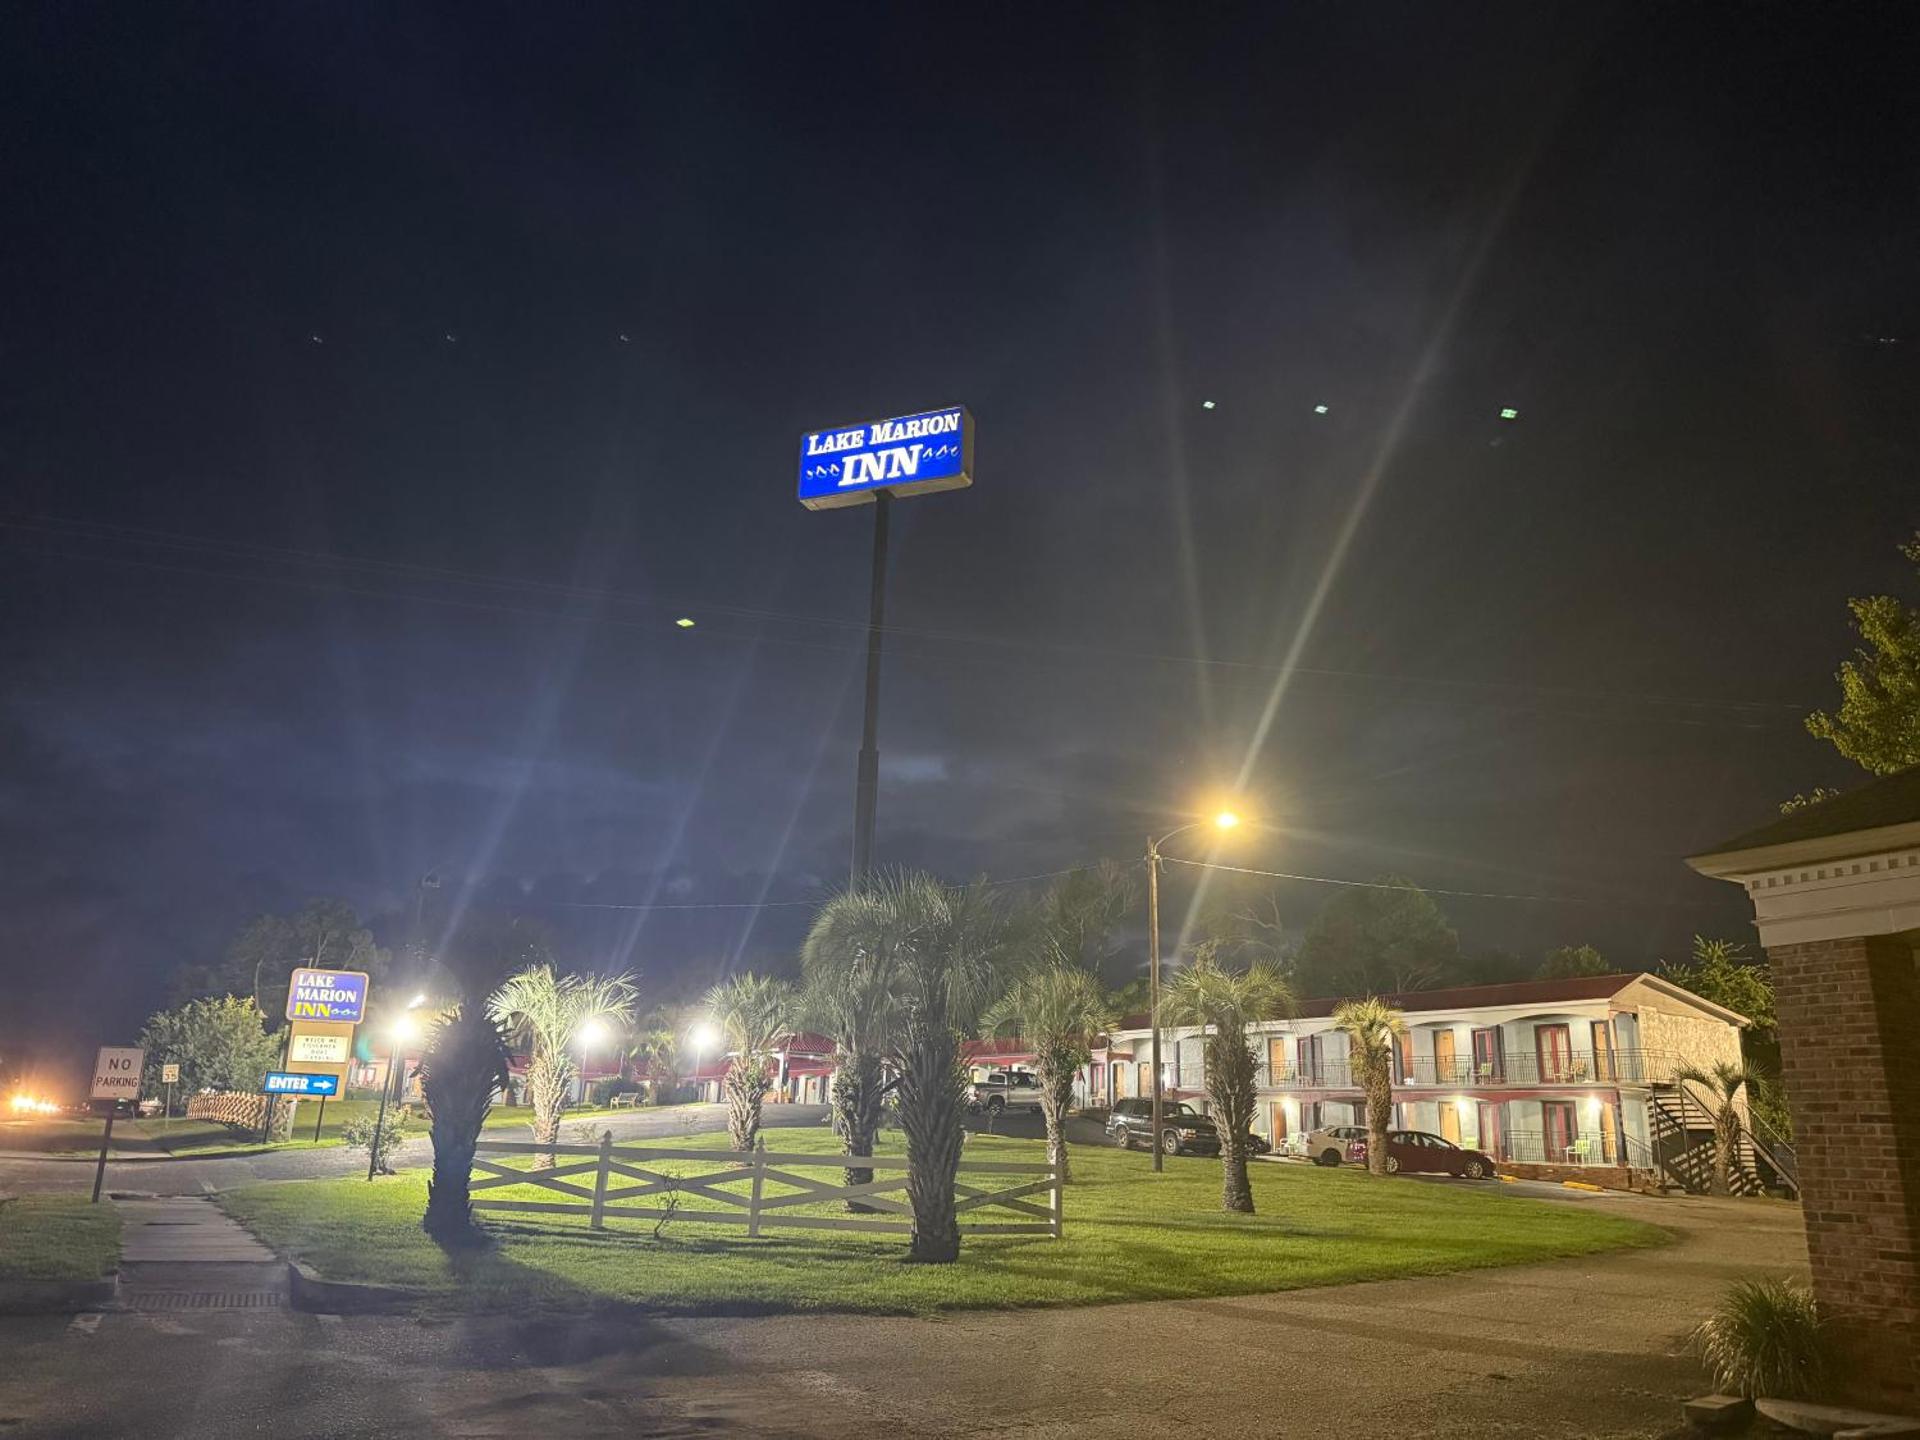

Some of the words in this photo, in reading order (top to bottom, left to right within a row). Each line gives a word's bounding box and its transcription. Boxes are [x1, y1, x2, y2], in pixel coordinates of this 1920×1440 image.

[806, 430, 865, 456] LAKE
[869, 413, 961, 445] MARION
[837, 444, 924, 487] INN
[298, 973, 335, 988] LAKE
[296, 987, 357, 1003] MARION
[294, 1001, 332, 1018] INN
[108, 1058, 131, 1071] NO
[95, 1076, 138, 1088] PARKING
[268, 1076, 309, 1090] ENTER
